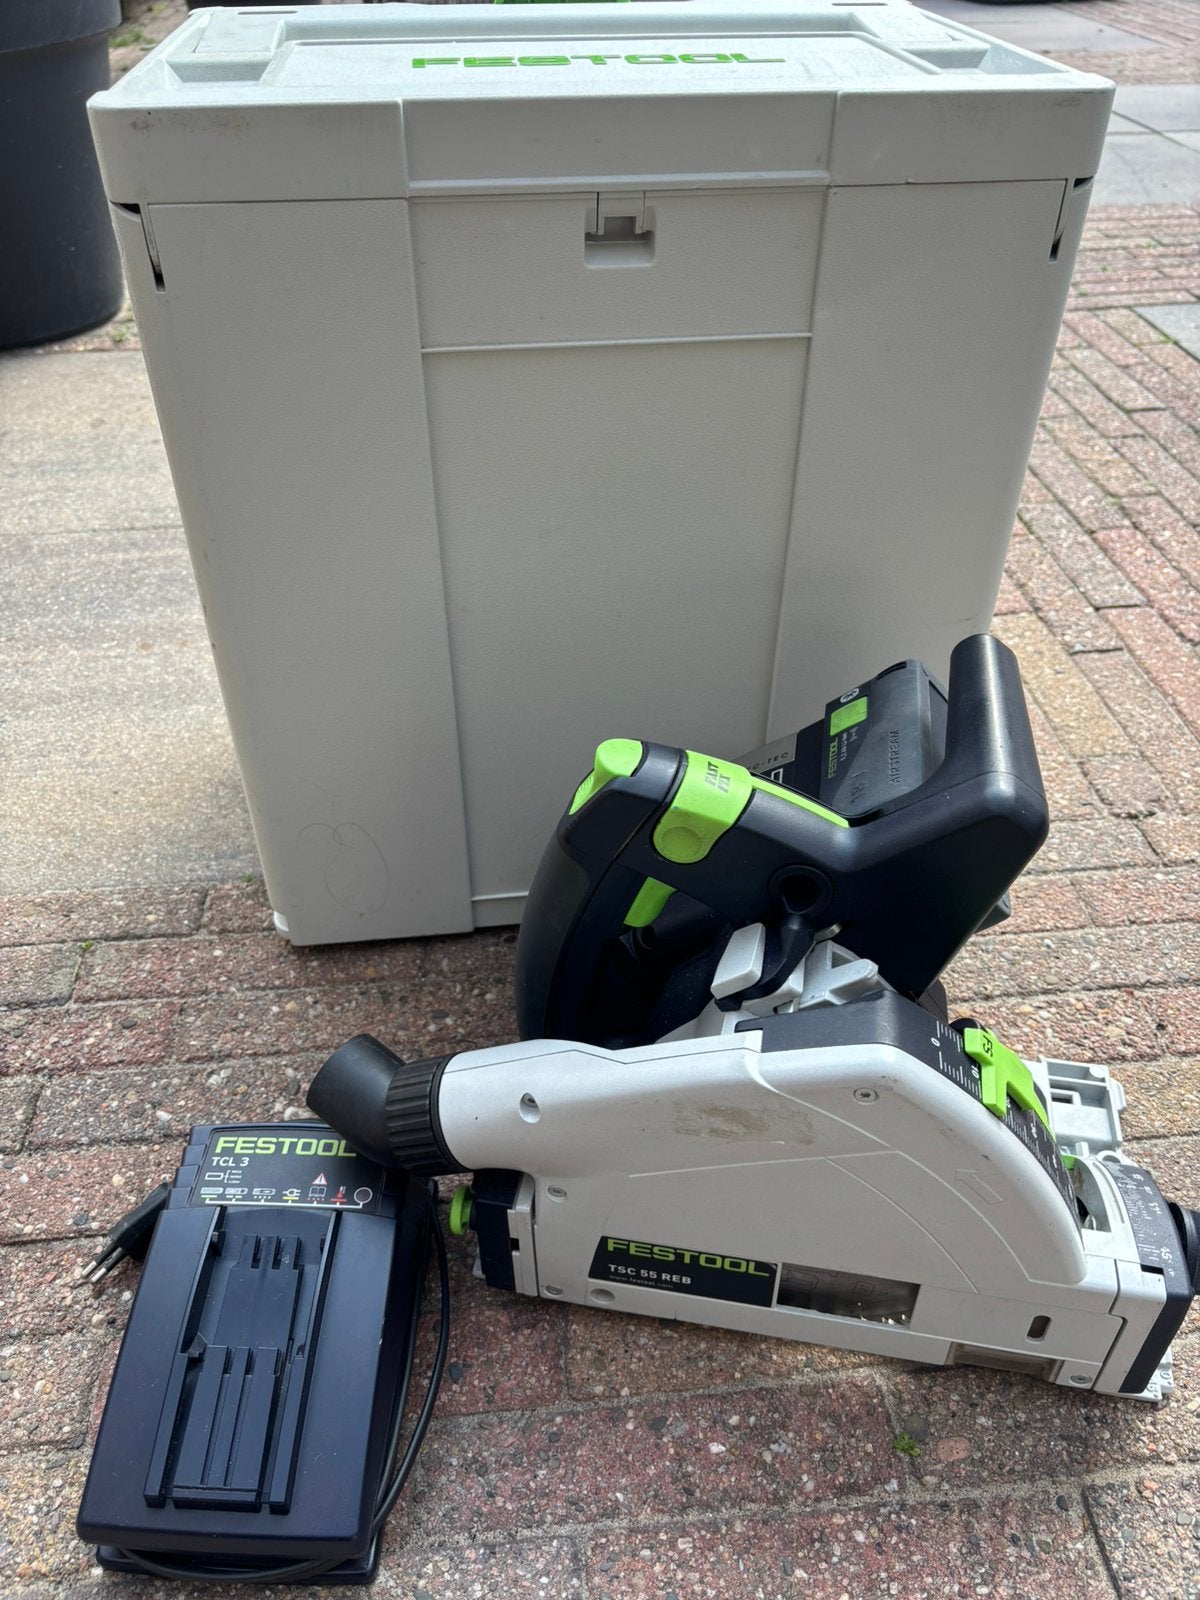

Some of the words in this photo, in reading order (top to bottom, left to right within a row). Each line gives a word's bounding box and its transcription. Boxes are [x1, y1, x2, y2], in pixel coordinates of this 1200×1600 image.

[411, 53, 786, 69] FESTOOL
[828, 736, 838, 779] FESTOOL
[888, 729, 901, 784] AIRSTREAM
[215, 1136, 357, 1157] FESTOOL
[211, 1156, 236, 1167] TCL
[240, 1156, 250, 1167] 3
[607, 1239, 769, 1276] FESTOOL
[608, 1264, 637, 1276] TSC
[640, 1269, 658, 1279] 55
[661, 1273, 692, 1285] REB
